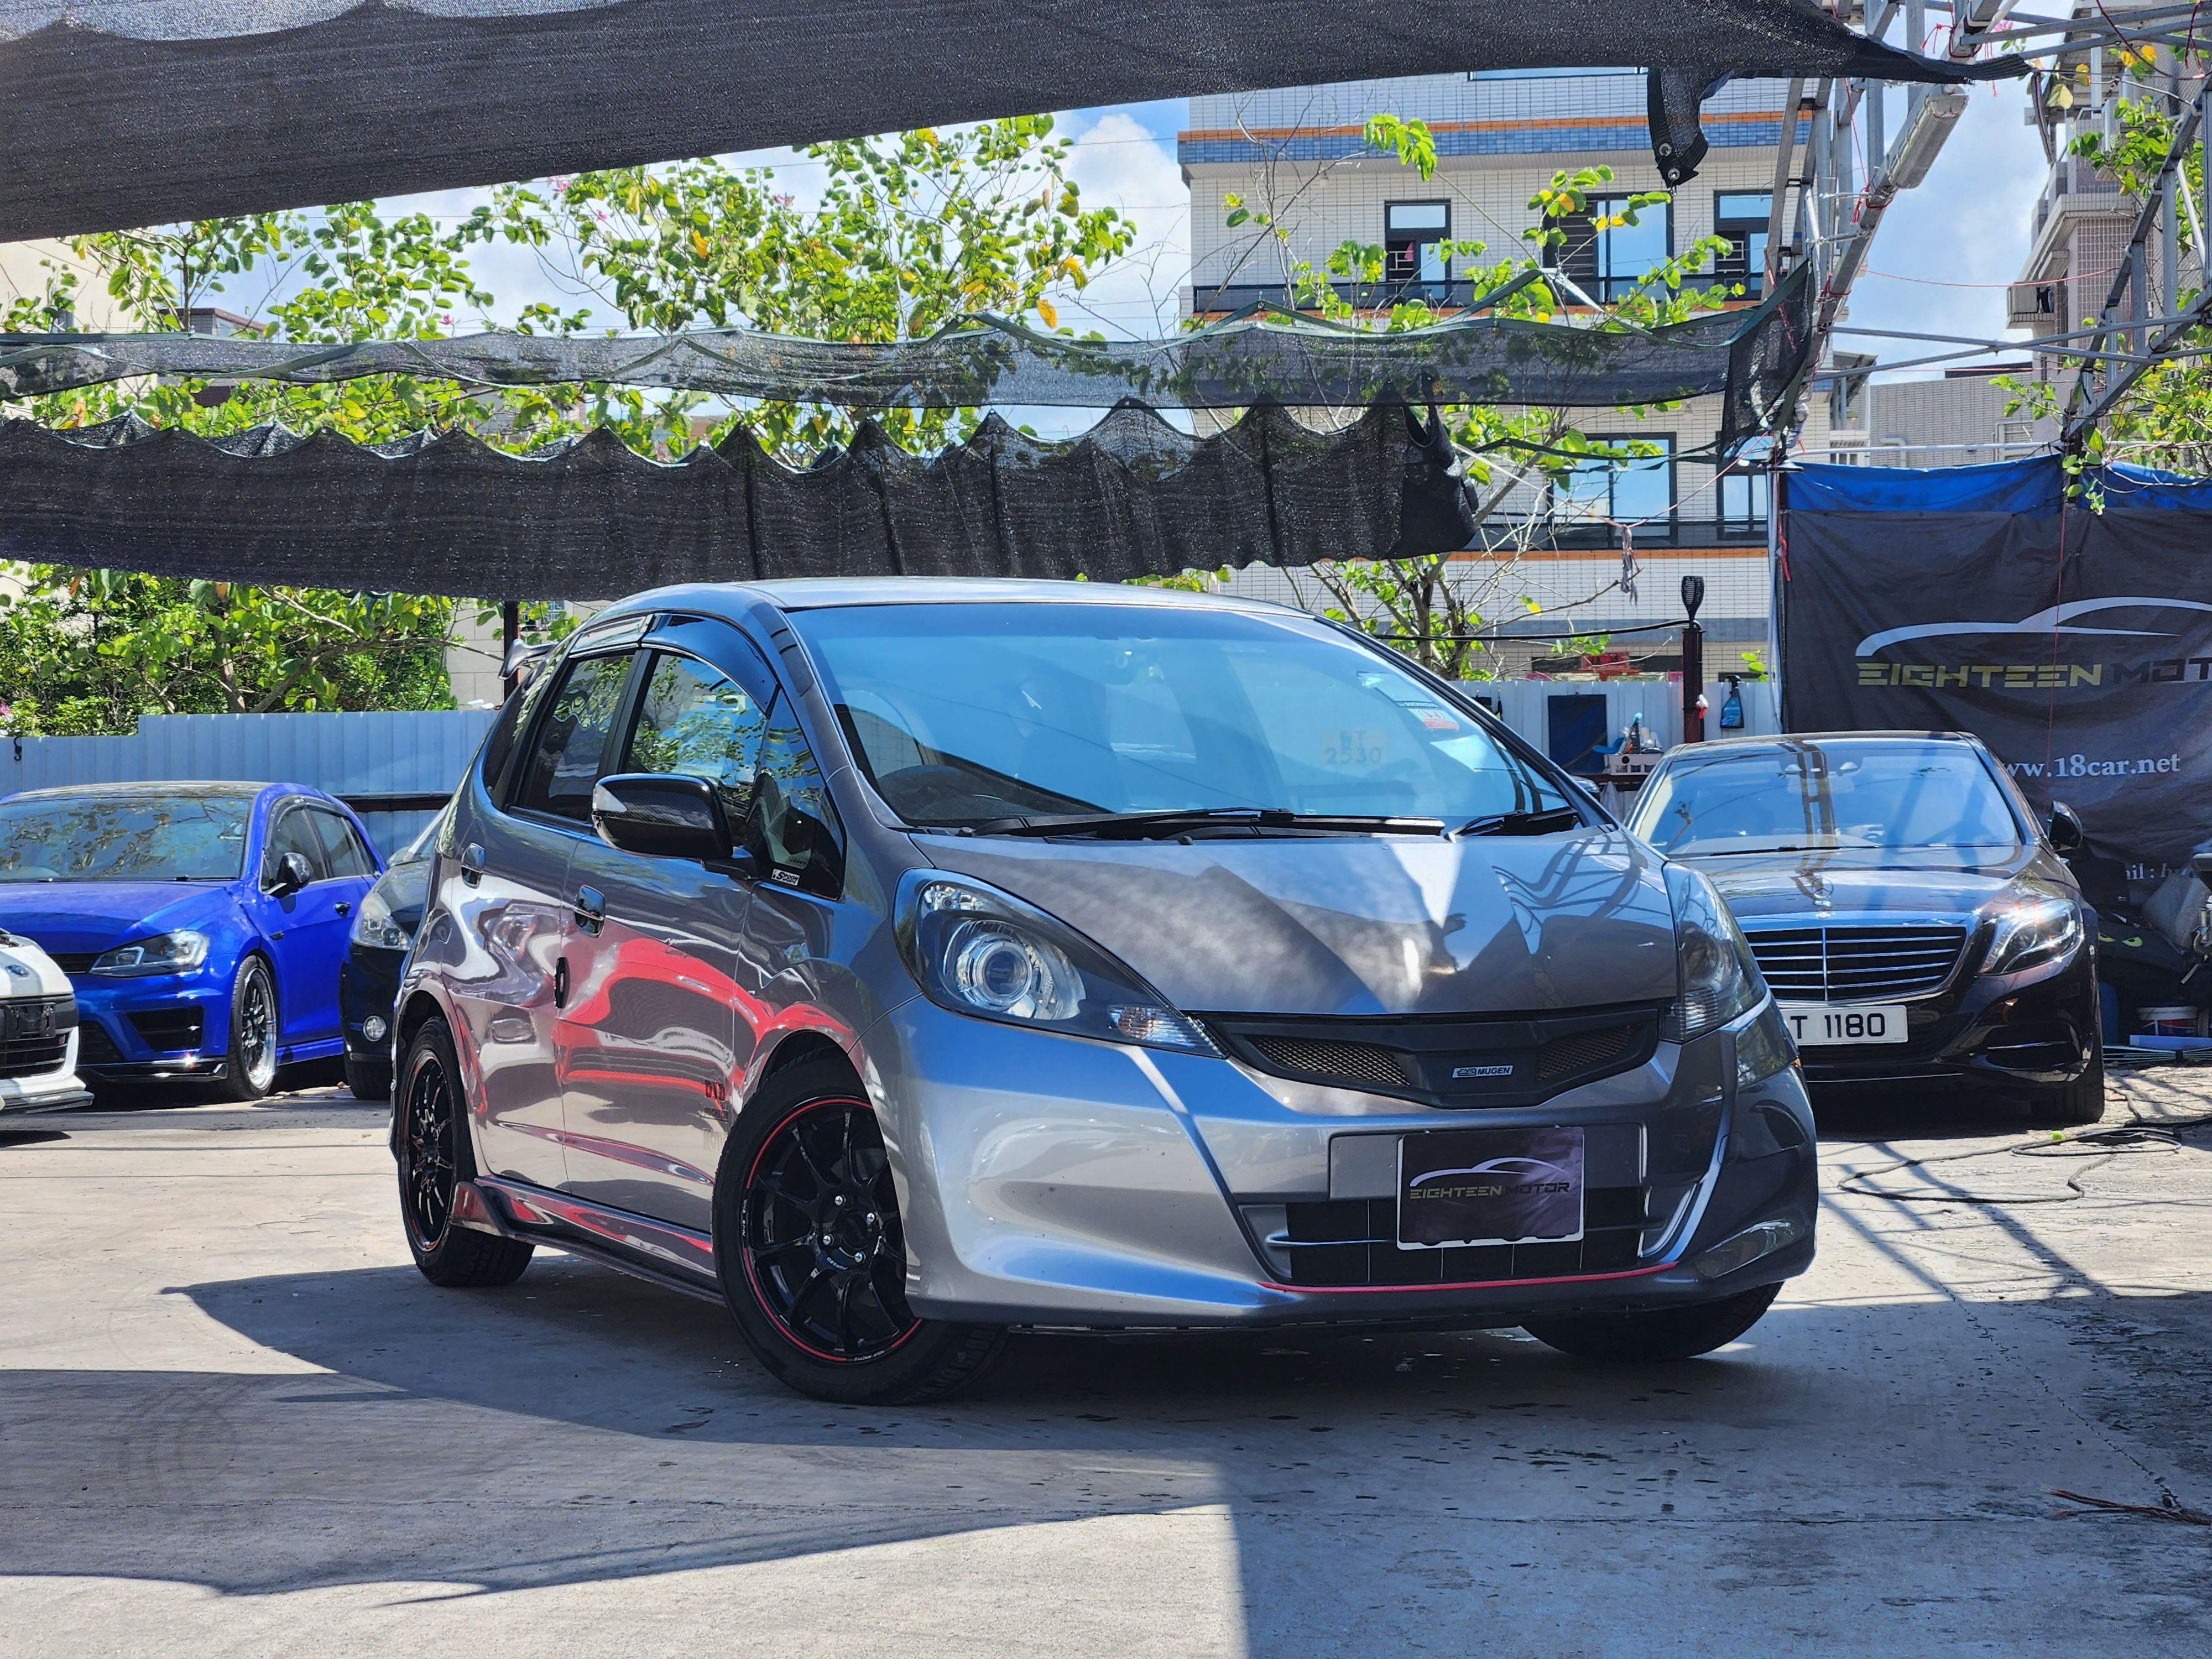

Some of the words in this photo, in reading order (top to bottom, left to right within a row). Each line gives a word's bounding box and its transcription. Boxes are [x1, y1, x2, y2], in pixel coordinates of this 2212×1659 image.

[1856, 663, 2102, 688] EIGHTEEN
[1824, 1013, 1886, 1038] 1180
[1477, 1067, 1511, 1076] MUGEN
[1410, 1185, 1503, 1199] EIGHTEEN
[1504, 1182, 1571, 1196] MOTOR
